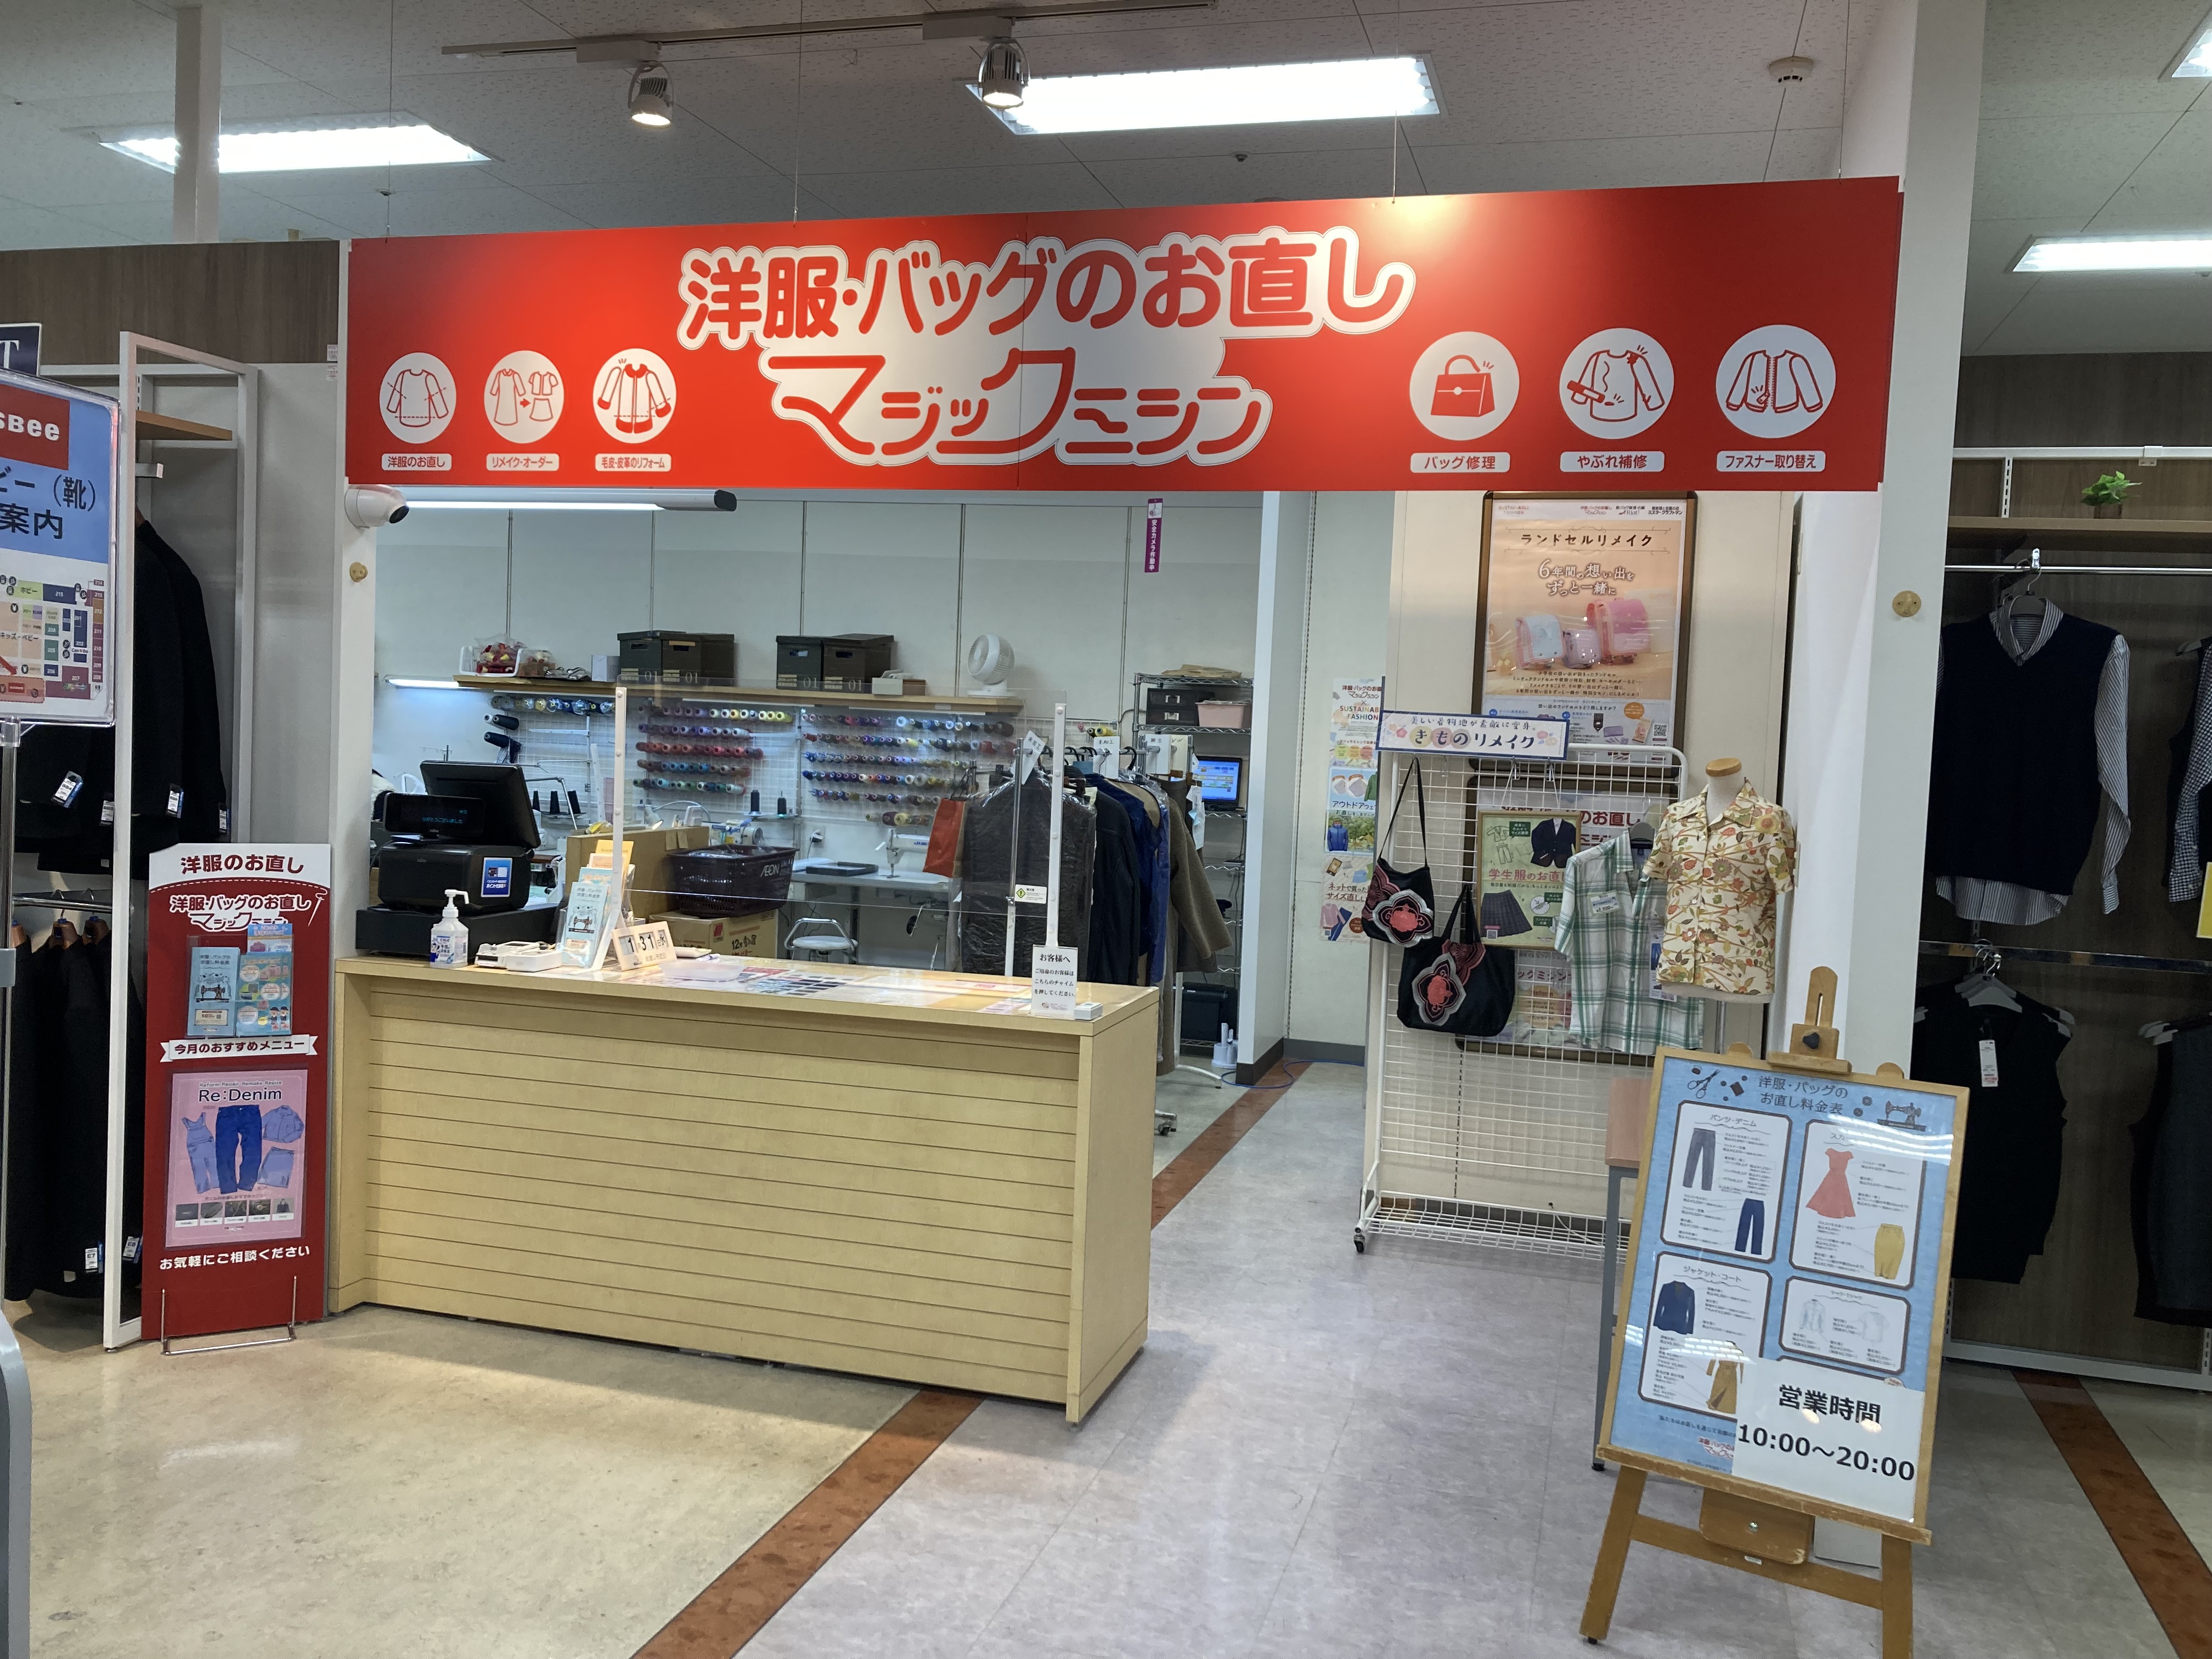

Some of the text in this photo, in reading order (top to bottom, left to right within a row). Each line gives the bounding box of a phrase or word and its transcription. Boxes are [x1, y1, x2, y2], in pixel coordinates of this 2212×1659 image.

[687, 235, 1404, 339] 洋服・バッグのお直し
[769, 348, 1261, 456] マジックミシン
[387, 455, 446, 469] 洋服のお直し
[492, 456, 554, 469] リメイク・オーダー
[601, 456, 665, 469] 毛皮・皮革のリフォーム
[1424, 455, 1496, 470] バッグ修理
[1577, 454, 1647, 470] やぶれ補修
[1725, 454, 1816, 470] ファスナー取り替え
[1521, 534, 1653, 547] ランドセルリメイク
[1538, 558, 1635, 581] 6年間の想い出を
[1547, 579, 1616, 596] ずっと一緒に
[644, 670, 658, 682] 01
[685, 672, 698, 684] 01
[803, 676, 820, 689] 01
[848, 679, 862, 691] 01
[1415, 729, 1535, 750] きものリメイク
[180, 854, 304, 874] 洋服のお直し
[1328, 882, 1370, 893] ネットで買った
[171, 895, 311, 911] 洋服・バッグのお直し
[1040, 953, 1071, 963] お客様へ
[1035, 968, 1074, 976] ご用命のお客様は
[1034, 978, 1074, 986] こちらのチャイム
[1034, 989, 1076, 997] を押してください。
[174, 1040, 305, 1055] 今月のおすすめメニュー
[1758, 1075, 1848, 1099] 洋服・バッグの
[1760, 1092, 1843, 1115] お直し料金表
[1709, 1114, 1757, 1127] パンツ・デニム
[159, 1244, 311, 1271] お気軽にご相談ください
[1683, 1265, 1742, 1283] ジャケット・コート
[1778, 1384, 1882, 1425] 営業時間
